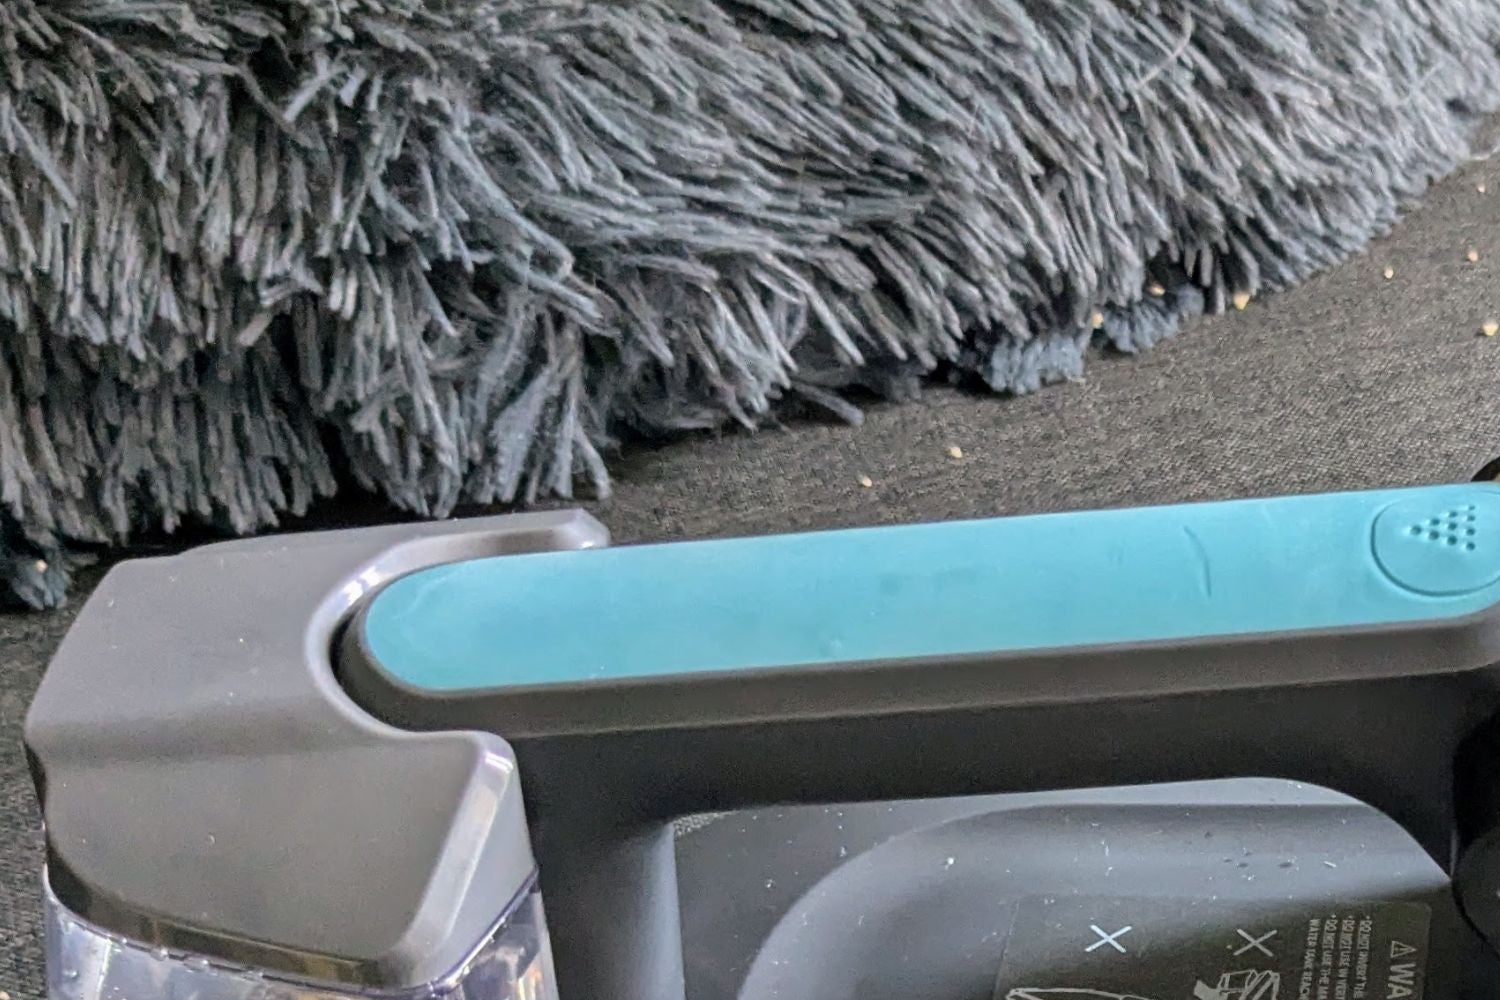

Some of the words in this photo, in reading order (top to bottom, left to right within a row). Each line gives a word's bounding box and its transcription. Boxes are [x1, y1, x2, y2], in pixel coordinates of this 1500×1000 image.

[1307, 918, 1319, 945] WATER
[1327, 919, 1336, 930] DO
[1345, 919, 1354, 930] DO
[1362, 920, 1372, 931] DO
[1325, 932, 1334, 948] NOT
[1342, 933, 1352, 948] NOT
[1360, 934, 1370, 949] NOT
[1304, 949, 1314, 968] TANK
[1323, 950, 1332, 964] USE
[1340, 951, 1350, 966] USE
[1339, 968, 1347, 977] IN
[1356, 951, 1368, 980] INVERT
[1320, 968, 1330, 984] THE
[1354, 982, 1365, 998] THE
